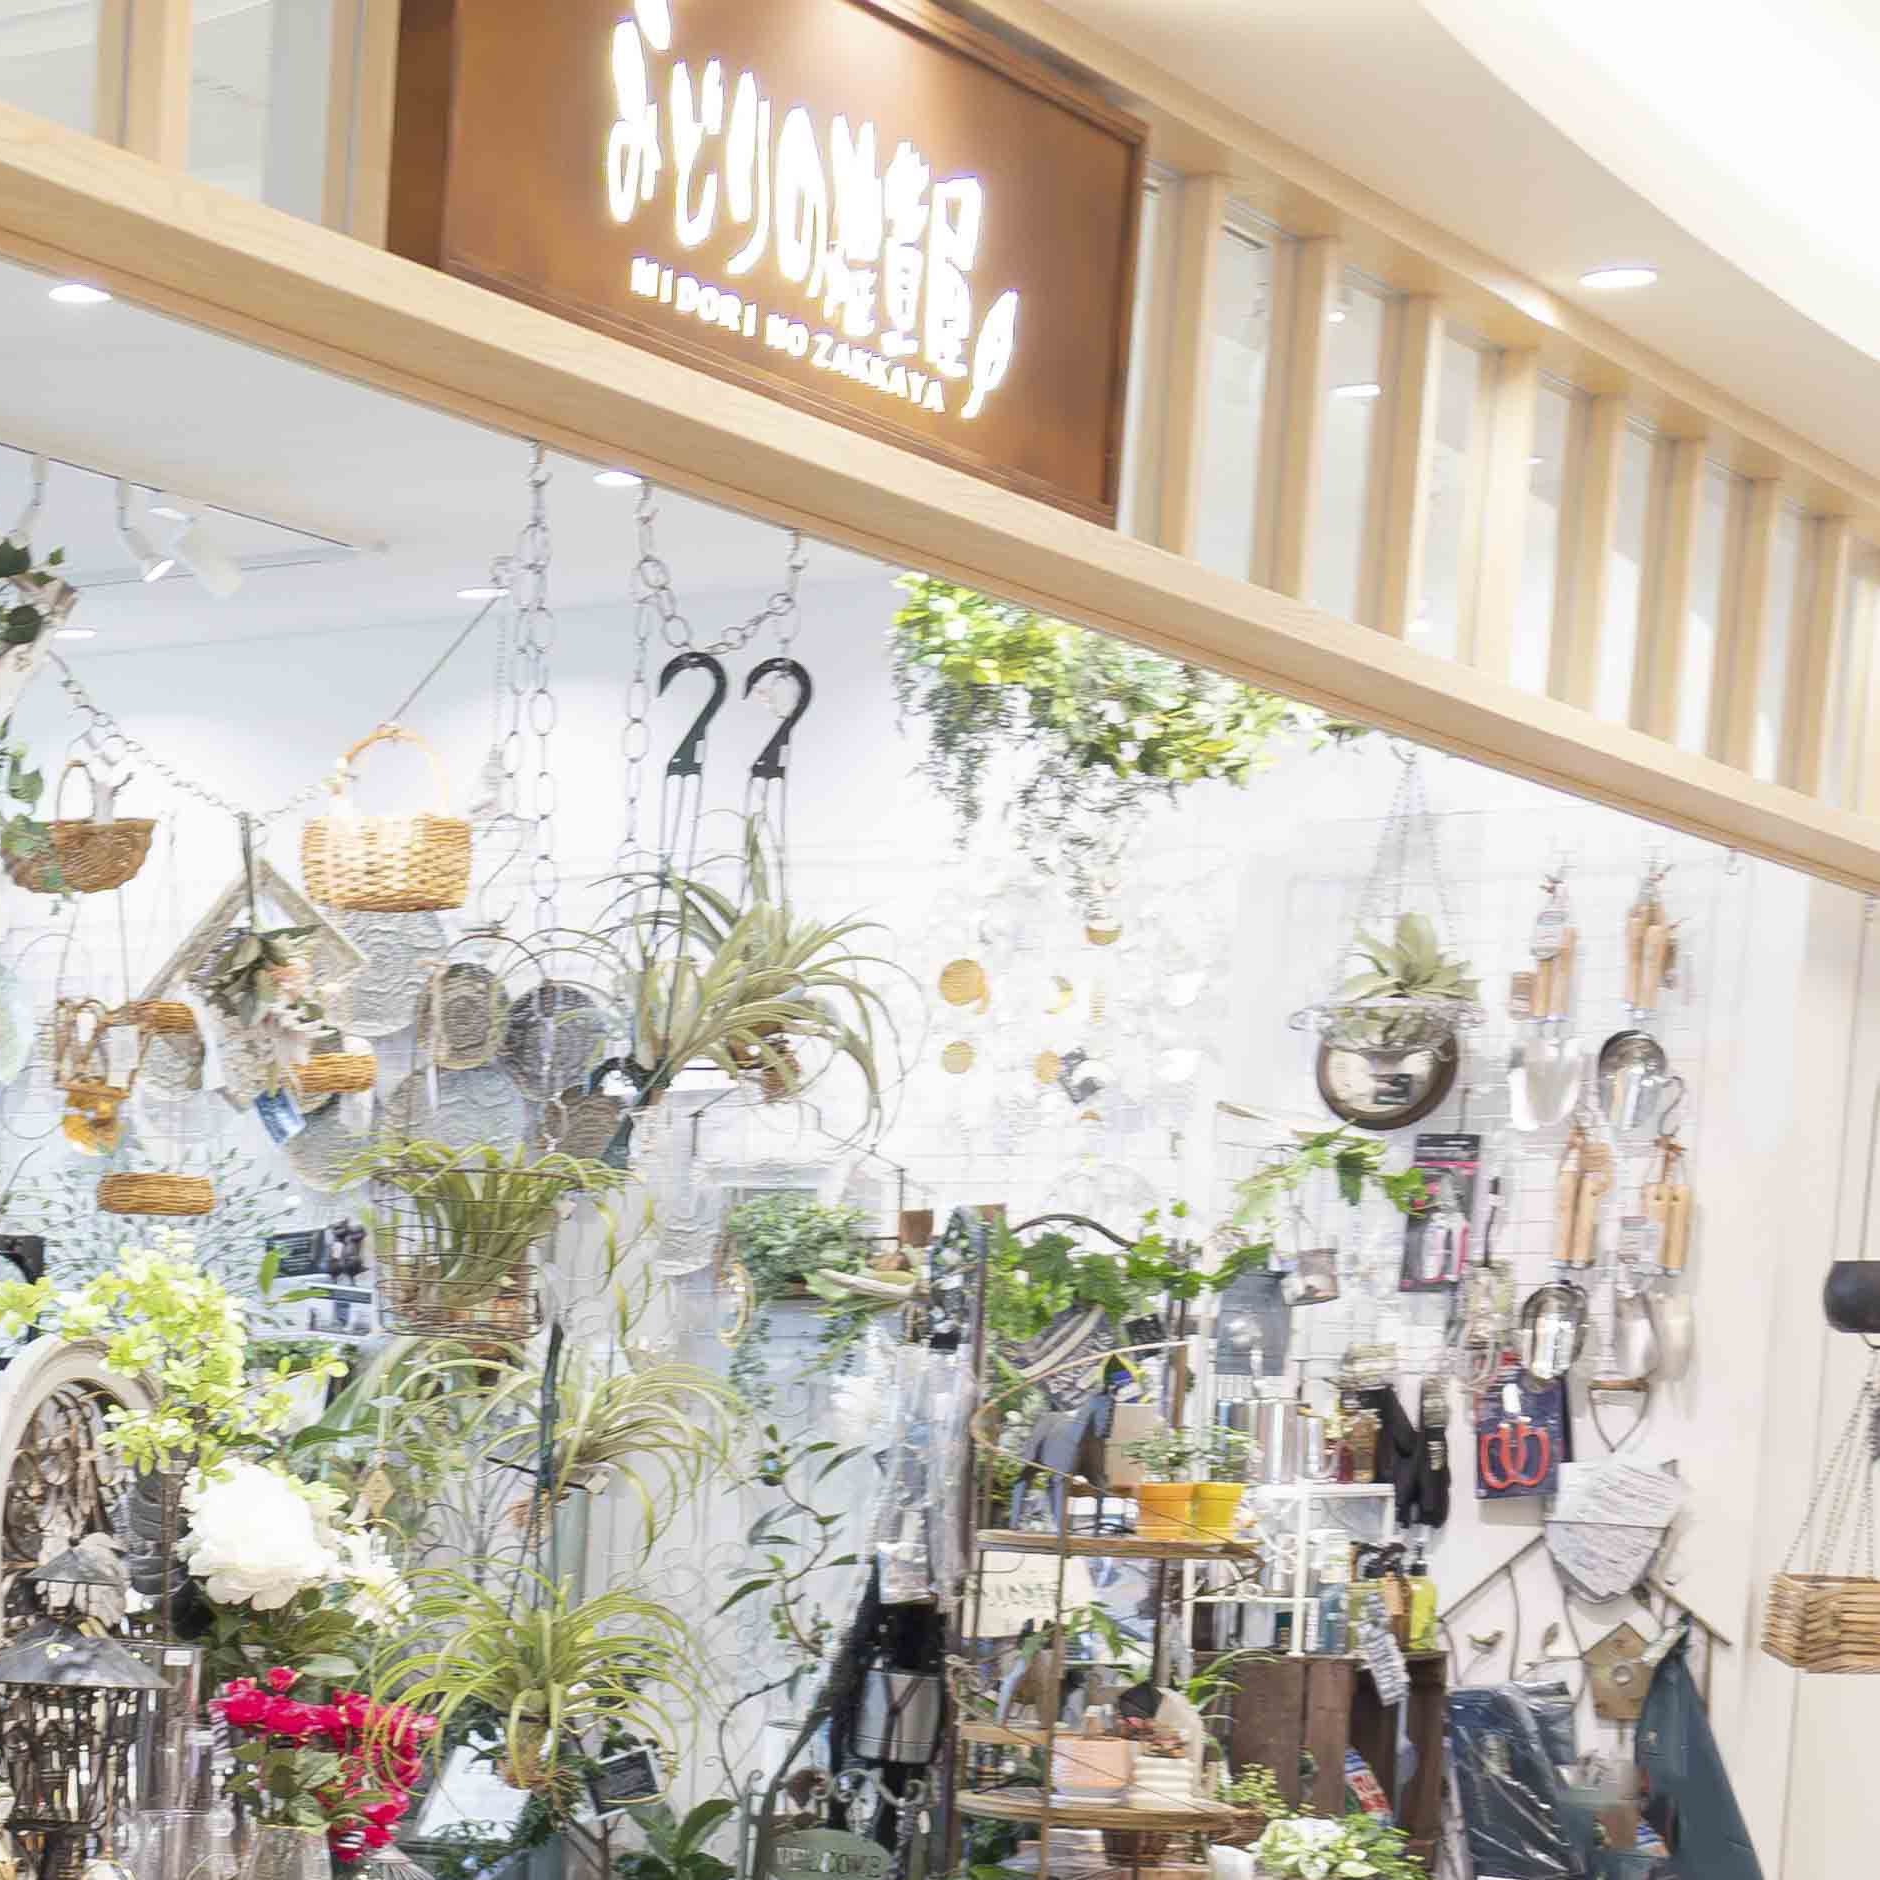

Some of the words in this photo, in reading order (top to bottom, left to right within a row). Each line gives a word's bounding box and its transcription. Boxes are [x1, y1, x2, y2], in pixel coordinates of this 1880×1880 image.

[630, 256, 757, 337] MIDORI
[765, 312, 810, 357] NO
[811, 330, 946, 413] ZAKKAYA
